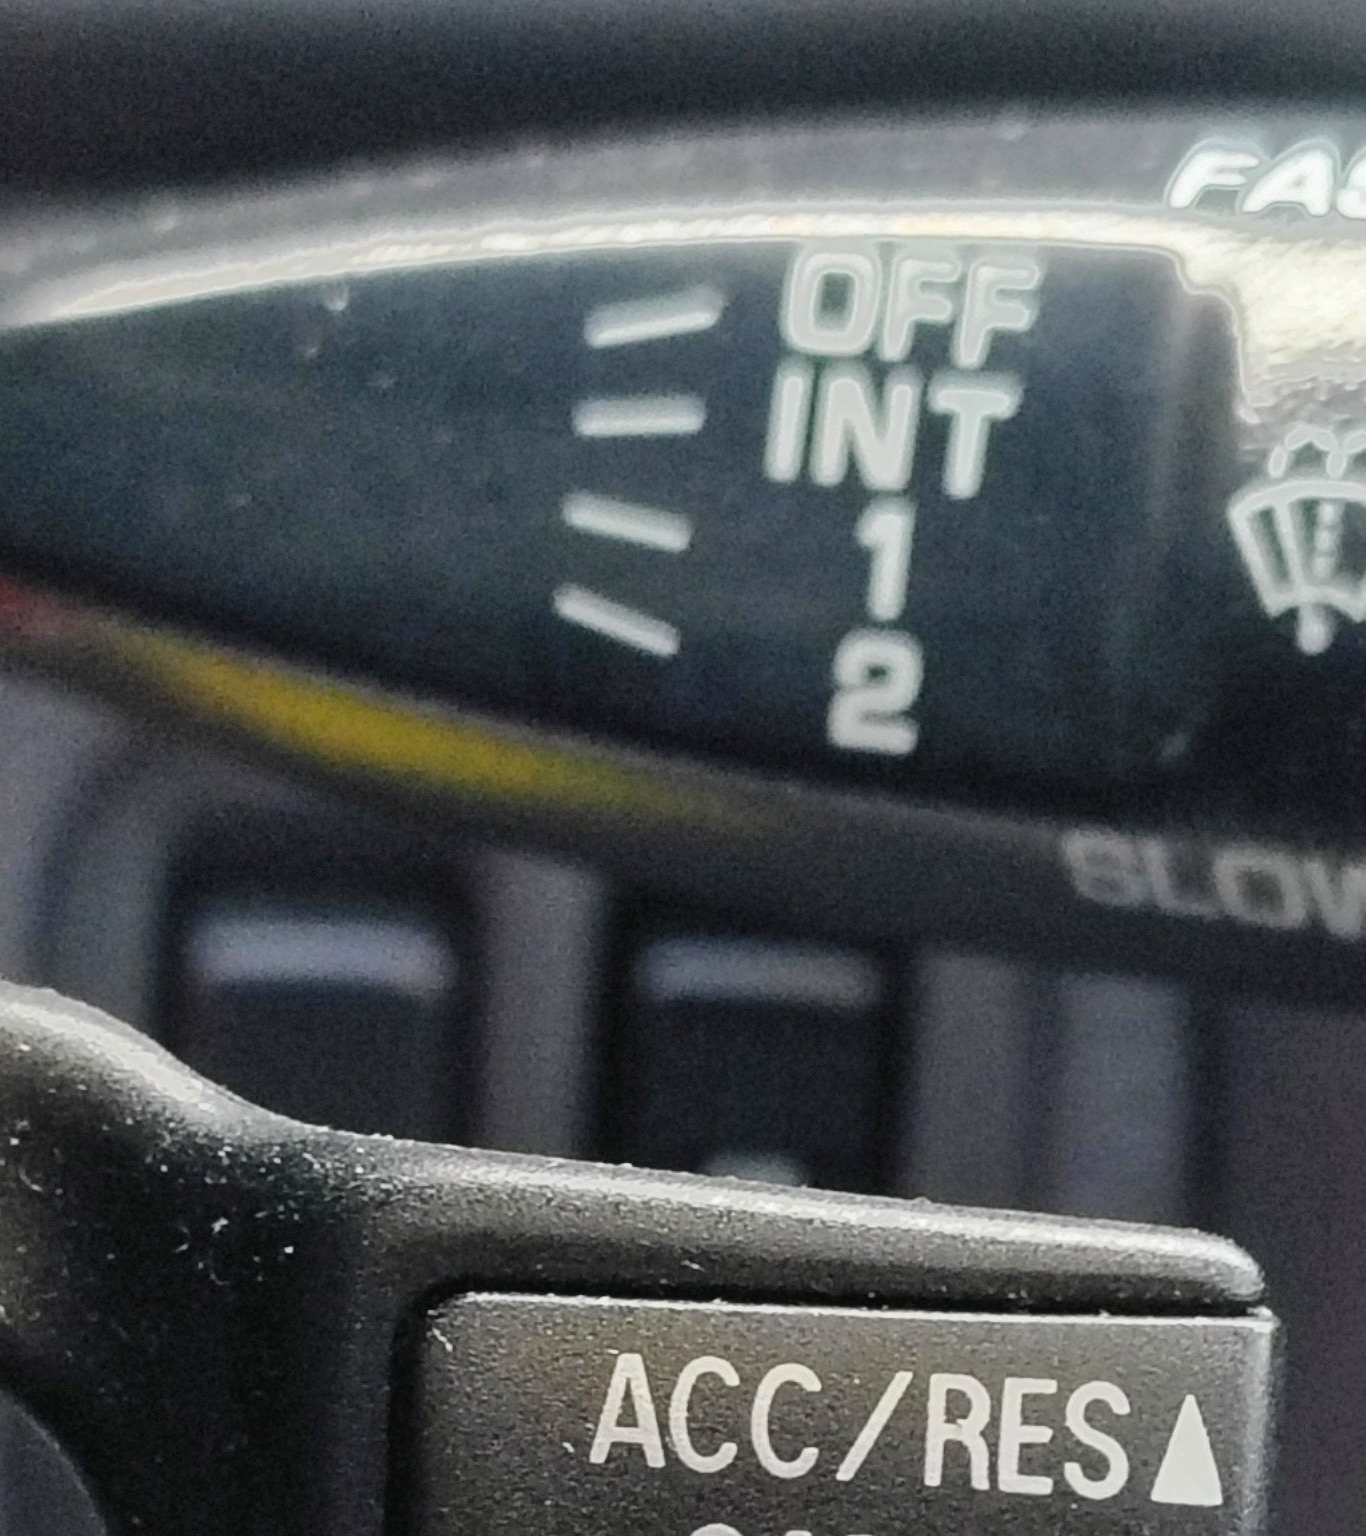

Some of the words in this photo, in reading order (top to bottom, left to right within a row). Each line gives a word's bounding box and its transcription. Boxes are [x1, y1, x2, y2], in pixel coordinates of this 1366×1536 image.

[782, 243, 1041, 368] OFF
[765, 358, 1023, 499] INT
[854, 497, 914, 622] 1
[828, 630, 923, 756] 2
[587, 1352, 1132, 1501] ACC/RES
